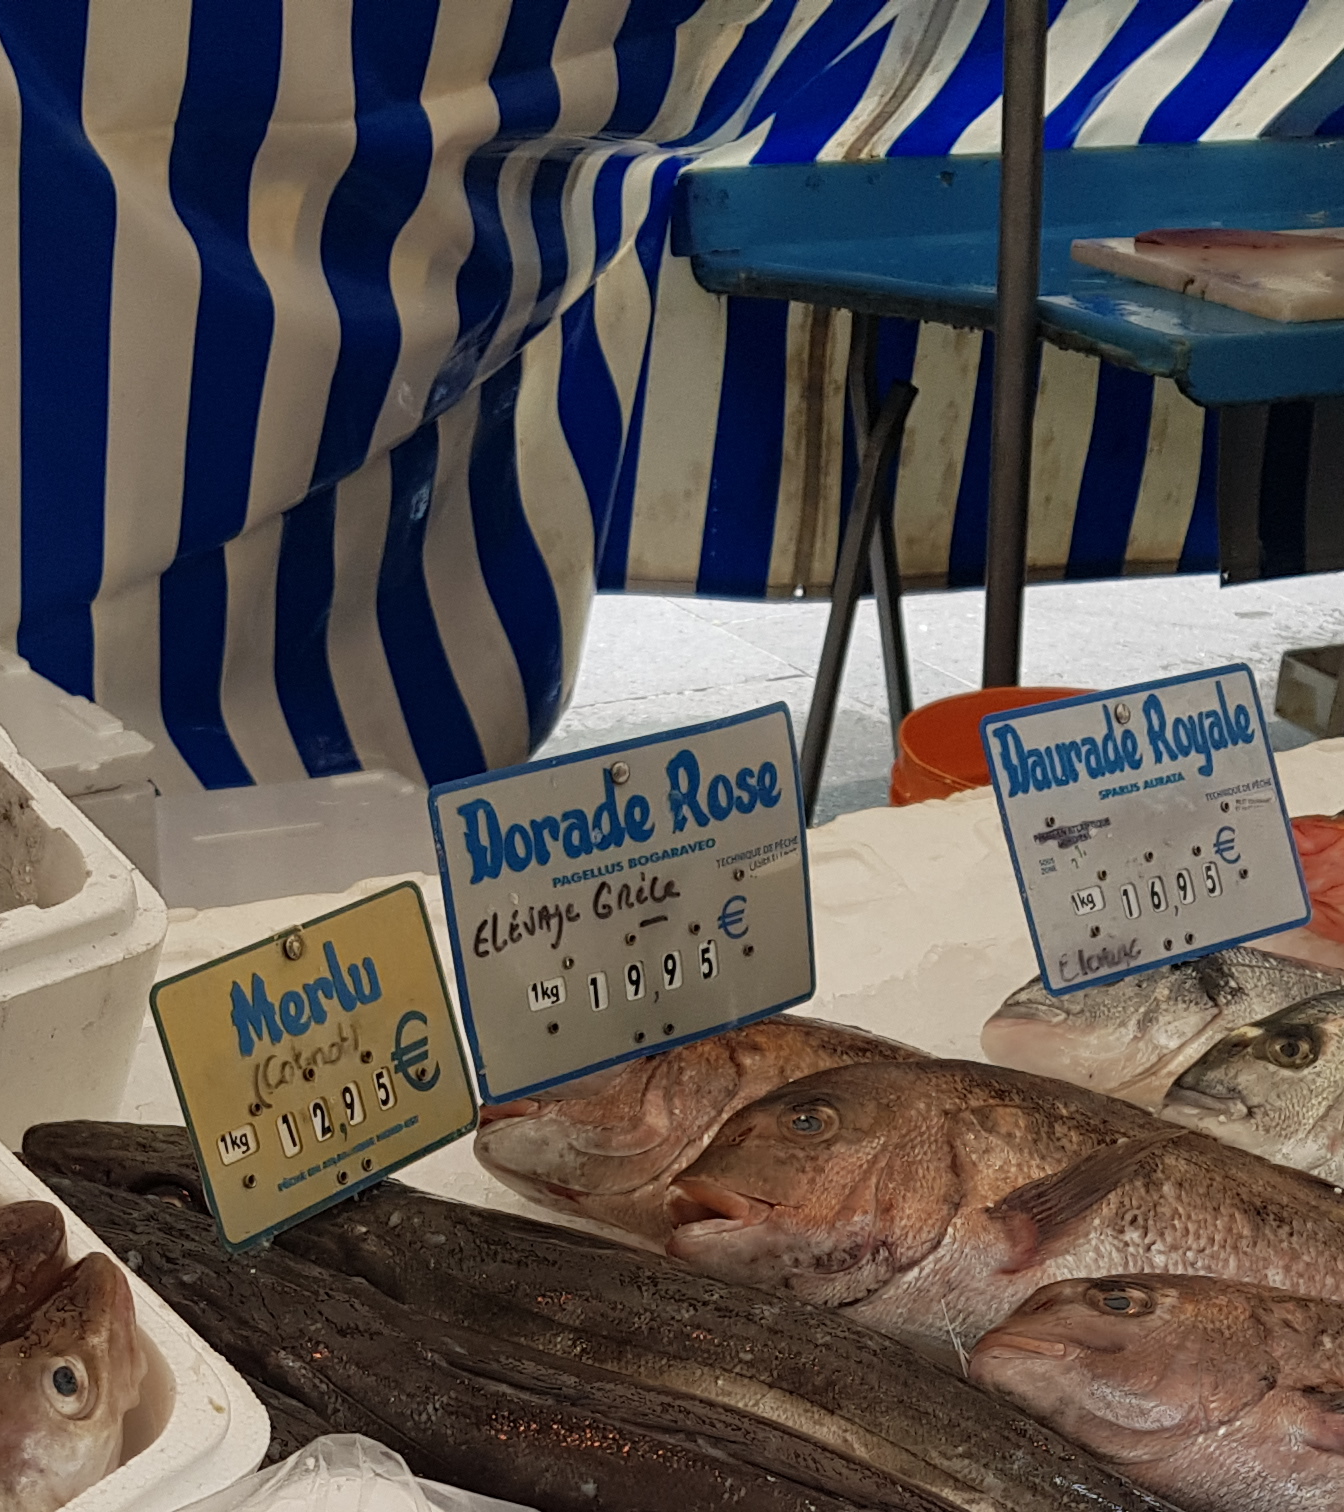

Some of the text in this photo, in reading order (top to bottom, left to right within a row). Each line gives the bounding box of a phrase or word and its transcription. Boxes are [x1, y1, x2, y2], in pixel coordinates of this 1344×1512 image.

[993, 680, 1255, 798] Daurade Royale
[1098, 772, 1185, 800] SPARUS AURATA
[457, 750, 781, 884] Dorade Rose
[552, 862, 625, 889] PAGELLUS
[628, 837, 716, 870] BOGARAVEO
[1071, 890, 1097, 913] 1kg
[1213, 825, 1241, 865] €
[230, 940, 382, 1057] Merlu
[530, 979, 561, 1003] 1kg
[717, 895, 749, 939] €
[219, 1131, 249, 1155] 1kg
[281, 1071, 392, 1142] 12,95
[391, 1010, 440, 1092] €
